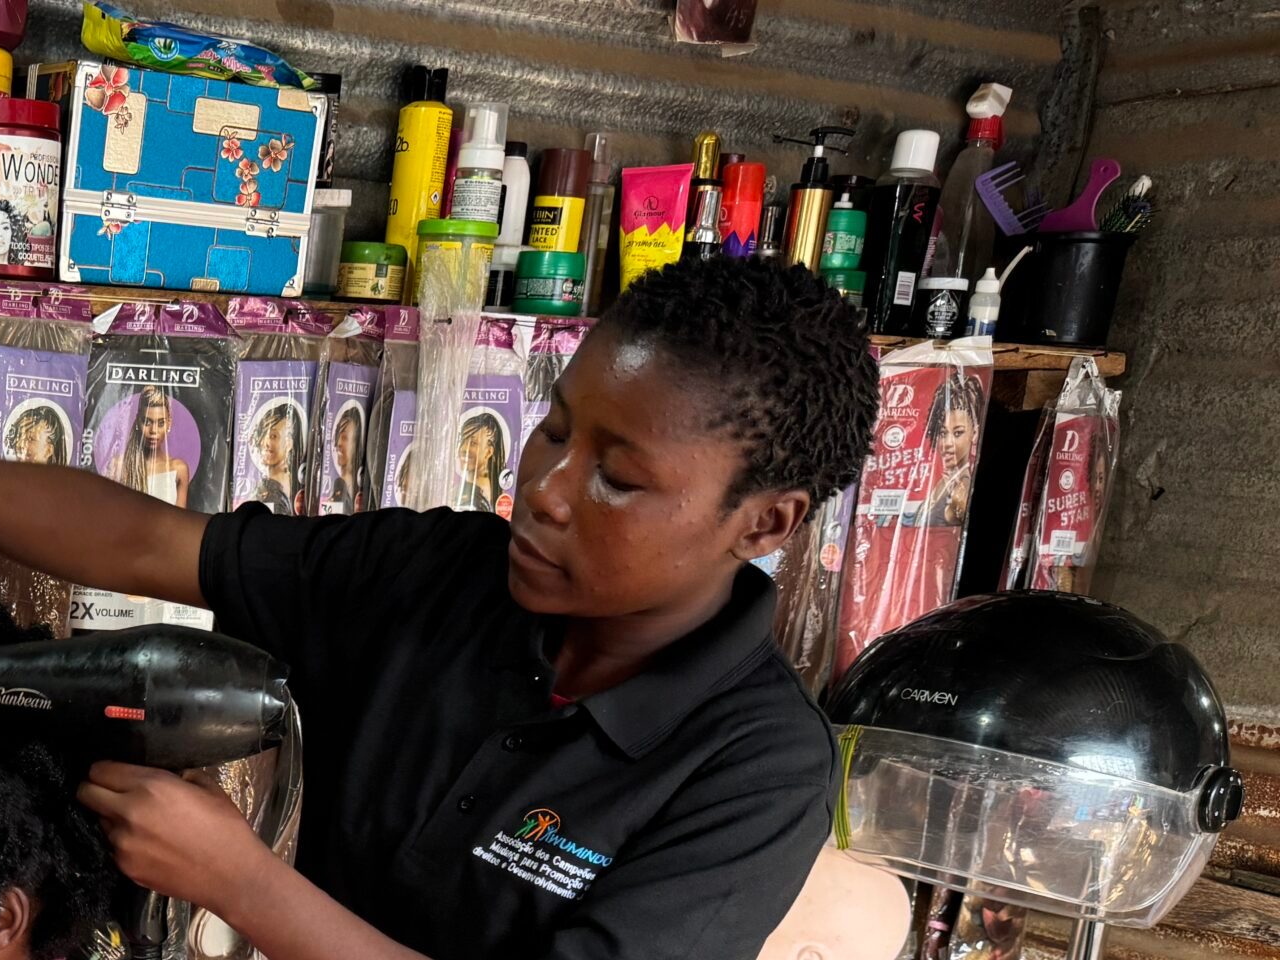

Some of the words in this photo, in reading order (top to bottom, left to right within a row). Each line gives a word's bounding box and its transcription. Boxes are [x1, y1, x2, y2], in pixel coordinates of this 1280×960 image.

[111, 367, 195, 383] DARLING
[10, 378, 69, 393] DARLING
[252, 379, 307, 390] DARLING
[338, 381, 368, 394] DARLING
[464, 390, 505, 401] ARLING
[878, 407, 920, 418] DARLING
[866, 447, 925, 472] SUPER
[1056, 452, 1084, 461] DARLING
[387, 454, 396, 483] Braid
[1048, 491, 1087, 513] SUPER
[1061, 507, 1089, 526] STAR
[70, 601, 95, 620] 2X
[95, 608, 134, 618] VOLUME
[901, 688, 958, 706] CARMEN
[494, 830, 534, 855] Associação
[535, 848, 550, 861] dos
[472, 846, 501, 866] direitos
[507, 862, 576, 900] Desenvolvimento
[520, 856, 539, 870] para
[539, 863, 584, 890] Promoção
